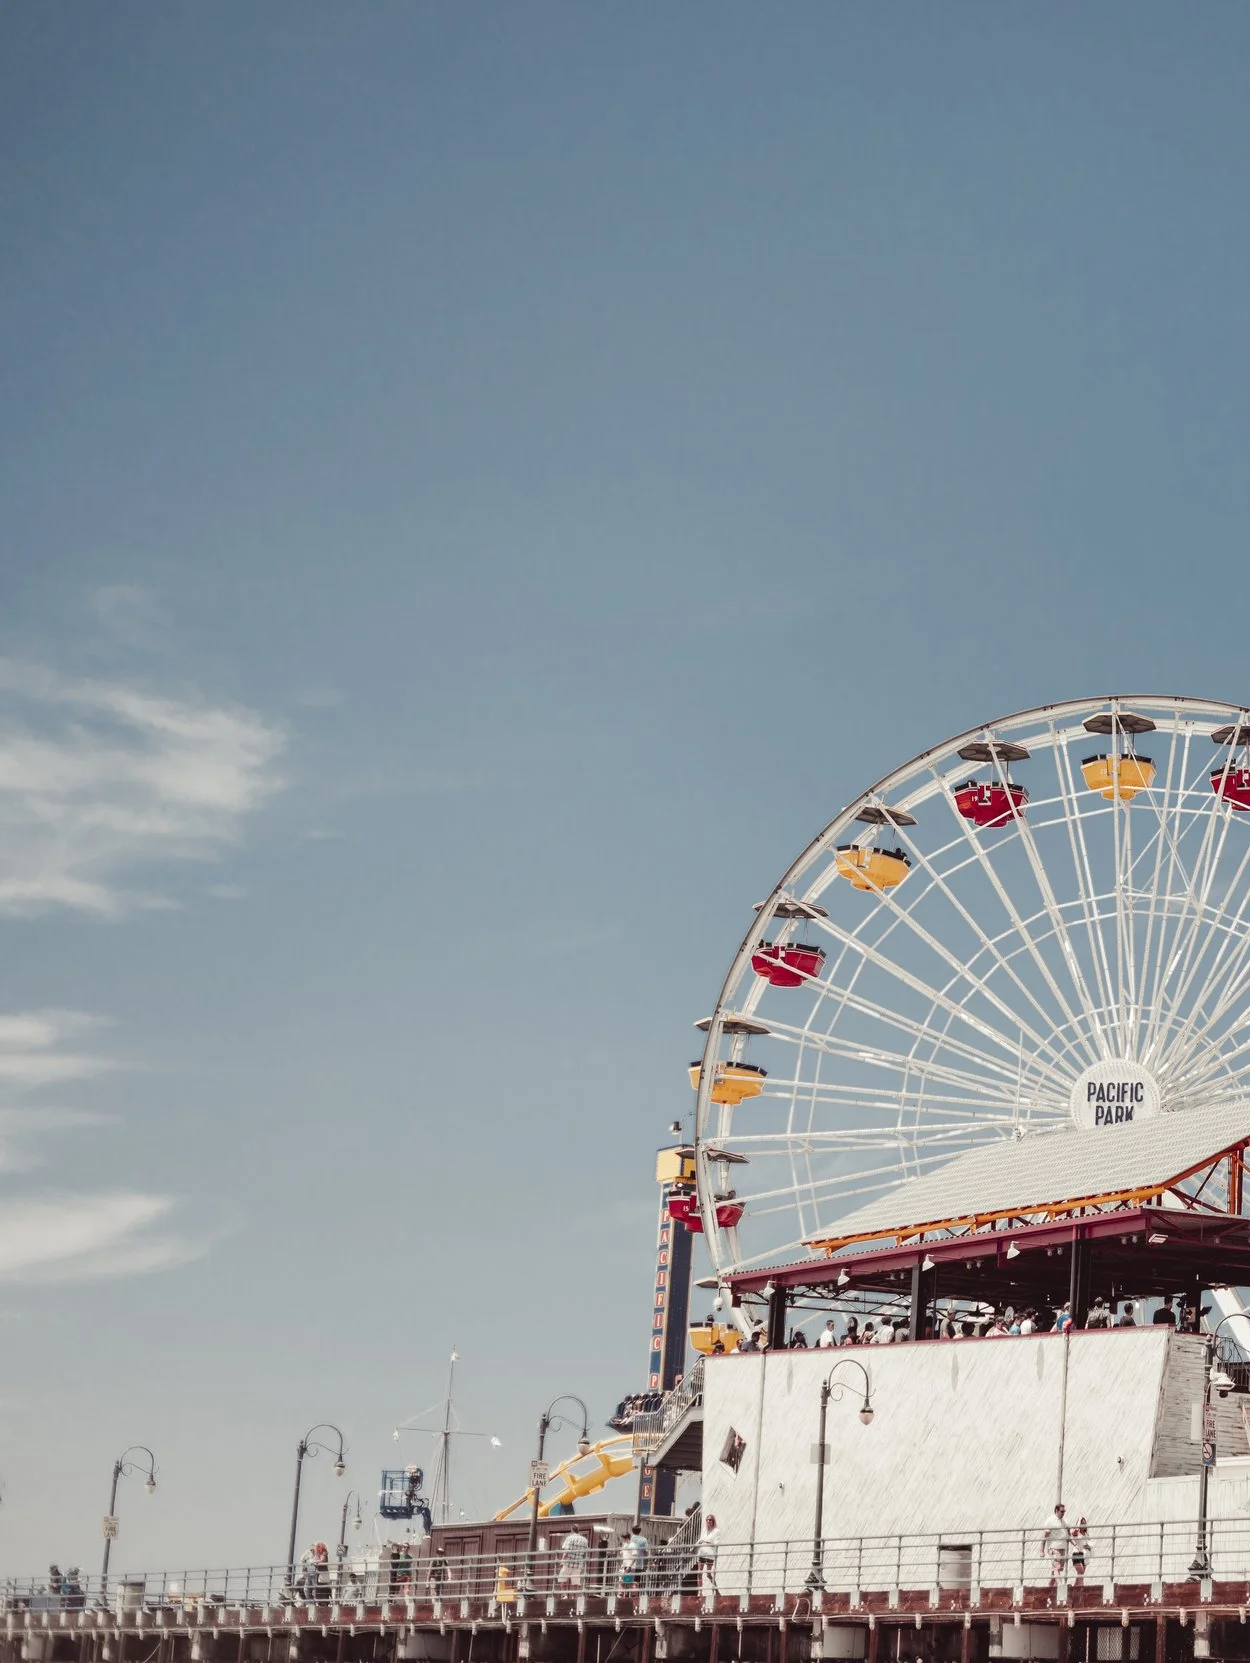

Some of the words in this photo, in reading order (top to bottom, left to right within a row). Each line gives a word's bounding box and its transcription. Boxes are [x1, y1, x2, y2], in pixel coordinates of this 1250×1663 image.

[1087, 1081, 1144, 1103] PACIFIC
[1095, 1105, 1134, 1126] PARK
[652, 1209, 670, 1351] PACIFIC
[533, 1472, 546, 1480] FIRE
